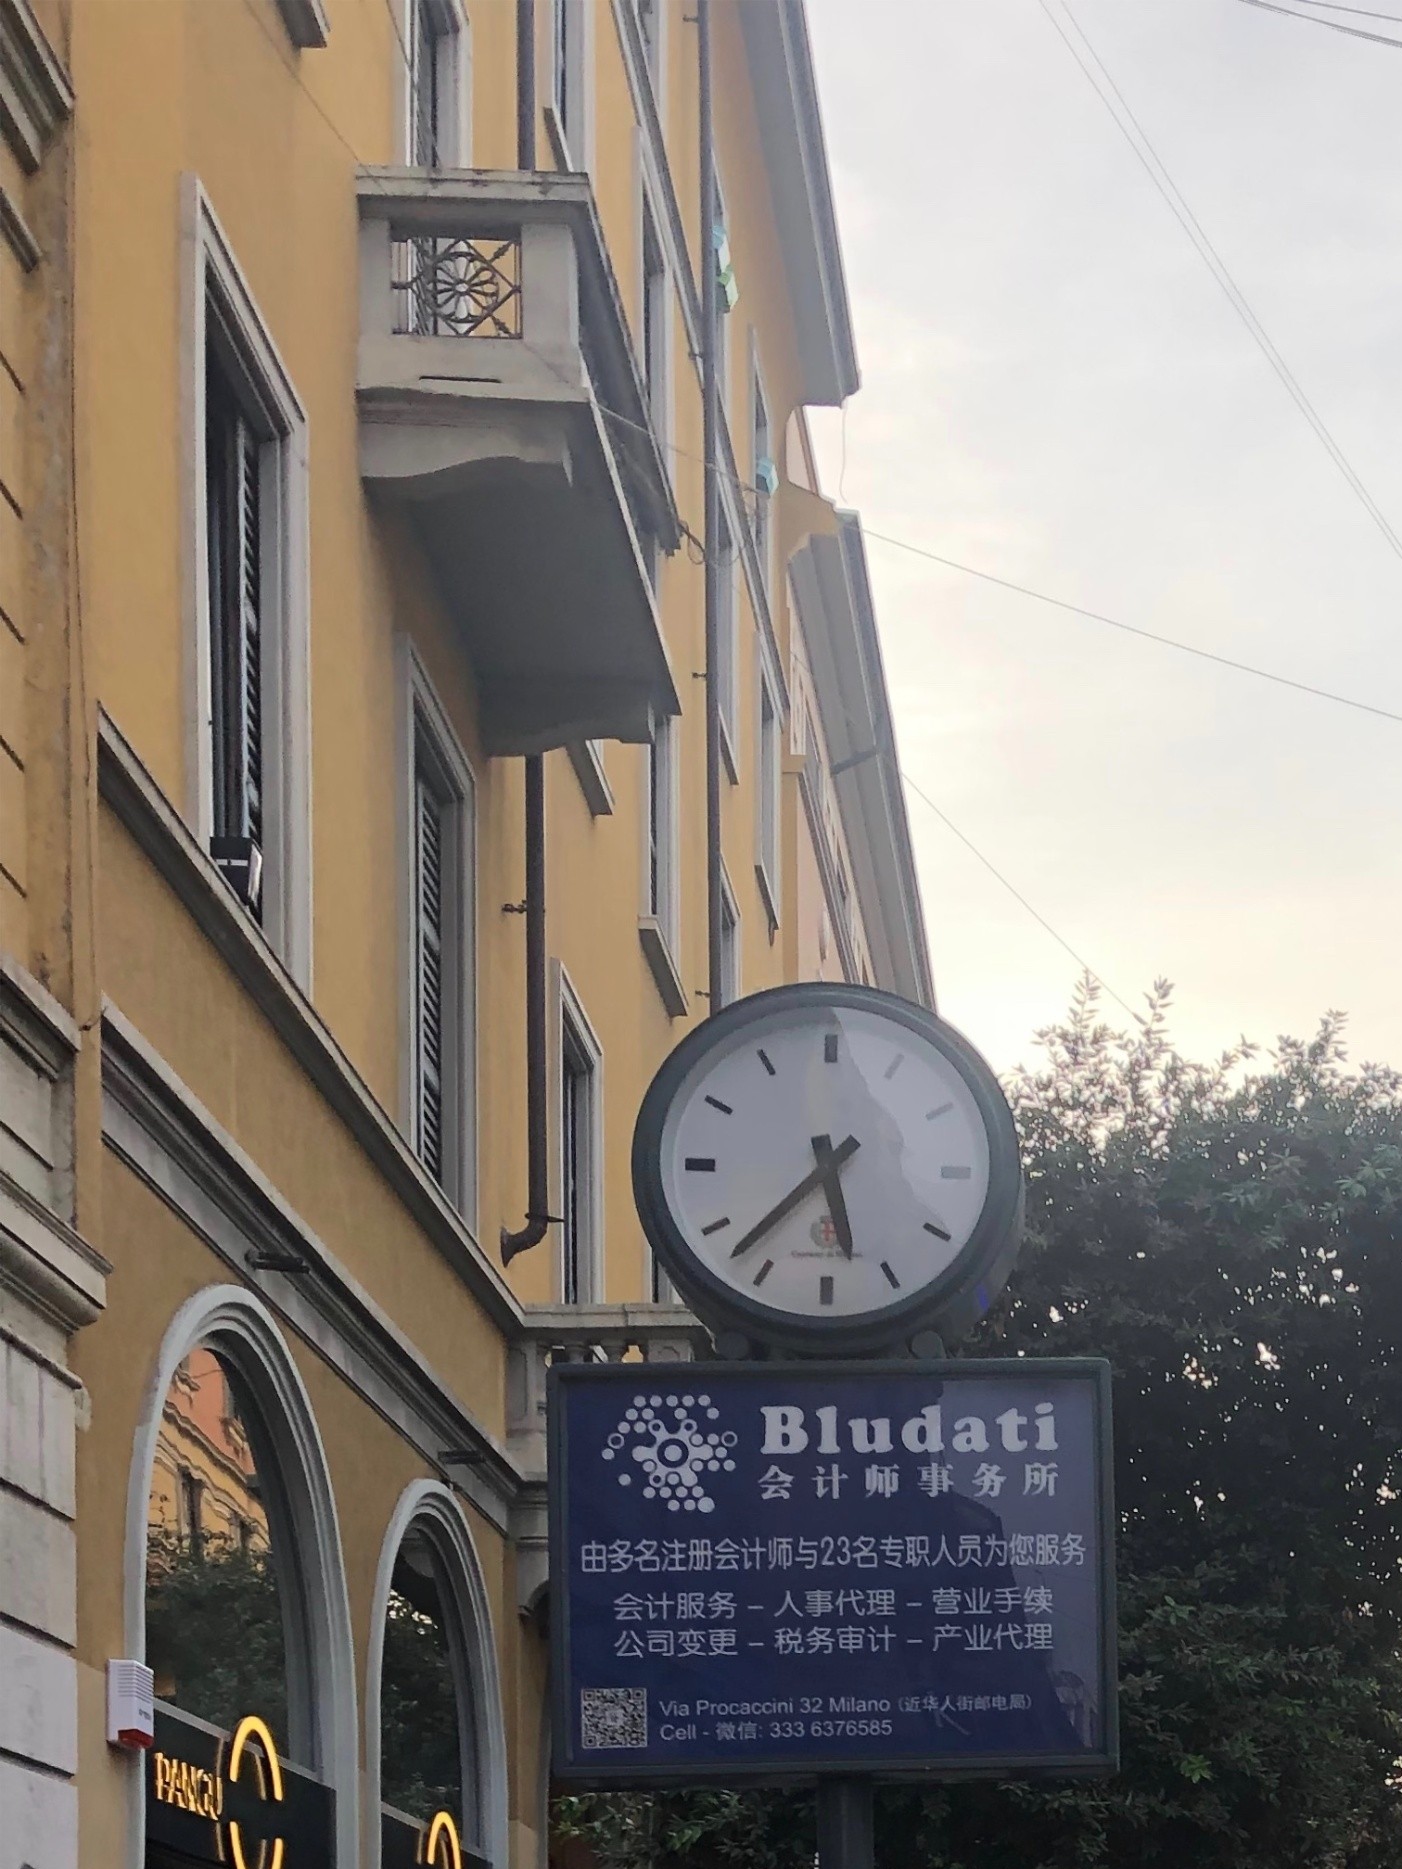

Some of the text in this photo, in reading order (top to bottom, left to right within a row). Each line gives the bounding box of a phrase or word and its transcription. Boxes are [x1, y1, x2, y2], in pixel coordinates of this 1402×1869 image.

[760, 1402, 1059, 1455] Bludati
[757, 1463, 1060, 1500] 会计师事务所
[580, 1532, 1088, 1574] 由多名注册会计师与23名专职人员为您服务
[613, 1591, 738, 1622] 会计服务
[773, 1589, 897, 1619] 人事代理
[931, 1585, 1054, 1616] 营业手续
[613, 1628, 739, 1659] 公司变更
[773, 1624, 897, 1655] 税务审计
[931, 1622, 1055, 1653] 产业代理
[659, 1700, 691, 1718] Via
[695, 1697, 794, 1717] Procaccini
[799, 1697, 824, 1714] 32
[829, 1696, 891, 1713] Milano
[660, 1724, 697, 1742] Cell
[769, 1721, 806, 1739] 333
[810, 1719, 893, 1738] 6376585
